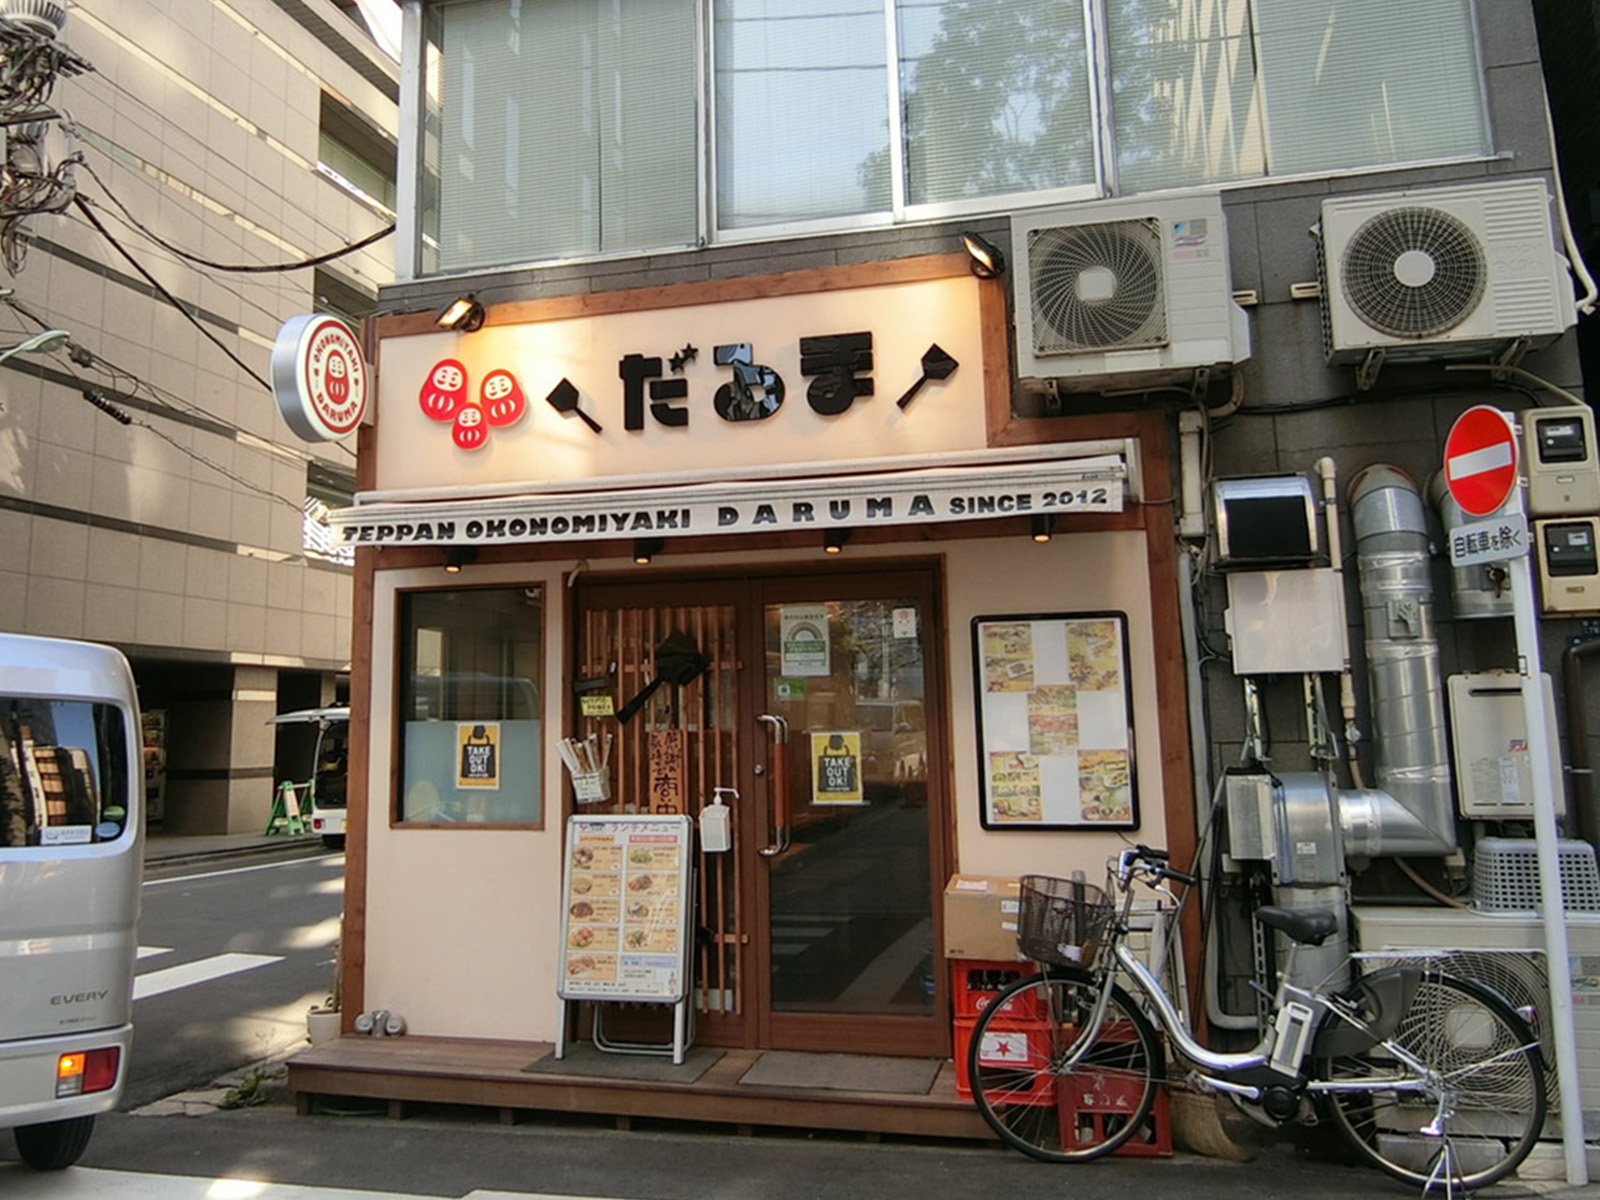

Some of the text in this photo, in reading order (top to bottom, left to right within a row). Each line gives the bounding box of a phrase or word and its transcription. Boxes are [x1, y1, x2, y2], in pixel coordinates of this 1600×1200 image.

[314, 334, 360, 373] OKONOMIYAKI
[619, 331, 874, 430] だるま
[317, 392, 358, 423] DARUMA
[342, 487, 1108, 542] TEPPAN OKONOMIYAKI DARUMA SINCE 2012
[1454, 525, 1522, 558] 自転車を除く
[467, 746, 491, 755] TAKE
[469, 755, 489, 764] OUT
[824, 757, 850, 768] TAKE
[470, 764, 487, 773] OK!
[826, 767, 849, 777] OUT
[828, 776, 847, 787] OK!
[50, 989, 109, 1005] EVERY
